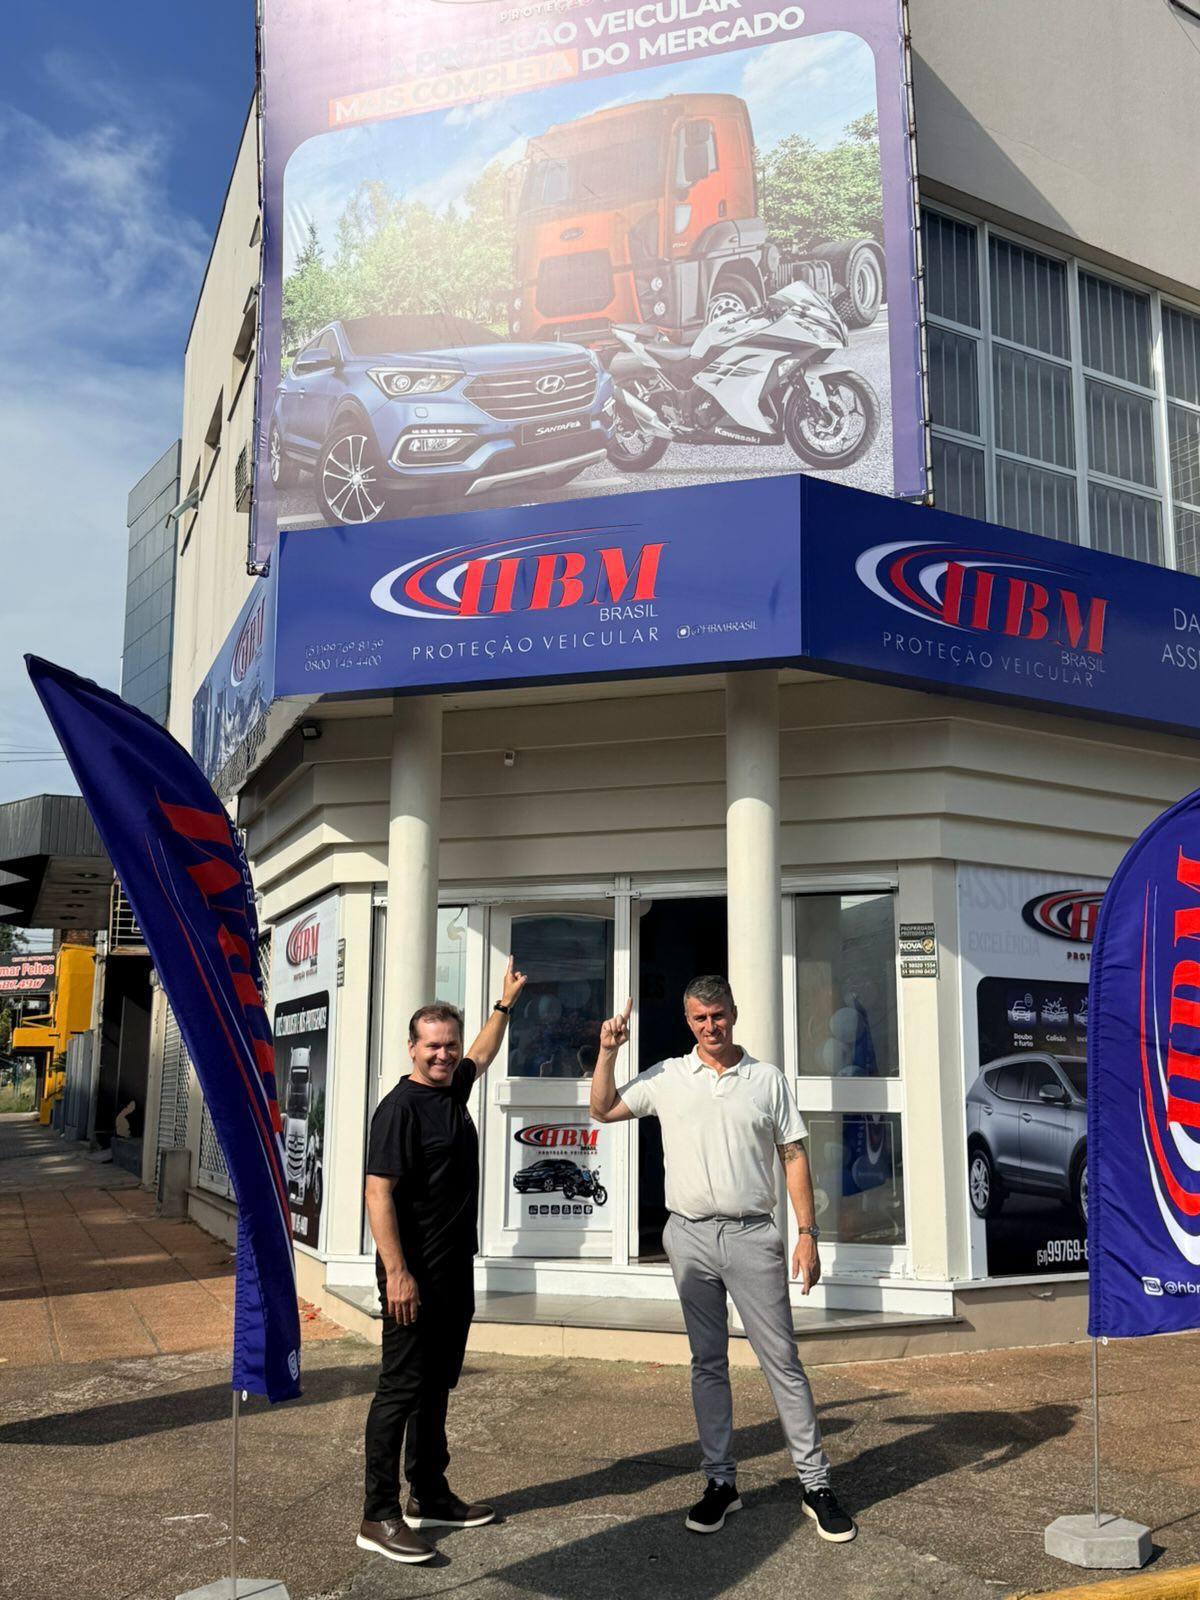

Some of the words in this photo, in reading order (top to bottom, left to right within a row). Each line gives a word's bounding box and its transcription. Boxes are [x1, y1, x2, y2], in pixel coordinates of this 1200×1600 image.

[415, 21, 578, 74] PROTEÇÃO
[335, 88, 405, 122] MAIS
[412, 54, 572, 104] COMPLETA
[582, 42, 630, 71] DO
[639, 6, 805, 60] MERCADO
[714, 426, 760, 444] Kawasaki
[459, 541, 670, 617] HBM
[599, 604, 658, 622] BRASIL
[942, 559, 1110, 655] HBM
[412, 635, 533, 660] PROTEÇÃO
[543, 627, 659, 650] VEICULAR
[1161, 643, 1200, 670] ASS
[883, 631, 993, 669] PROTEÇÃO
[1000, 656, 1094, 688] VEICULAR
[1060, 650, 1106, 673] BRASIL
[900, 942, 922, 950] NOVA
[21, 962, 54, 976] Feltes
[540, 1129, 600, 1147] HBM
